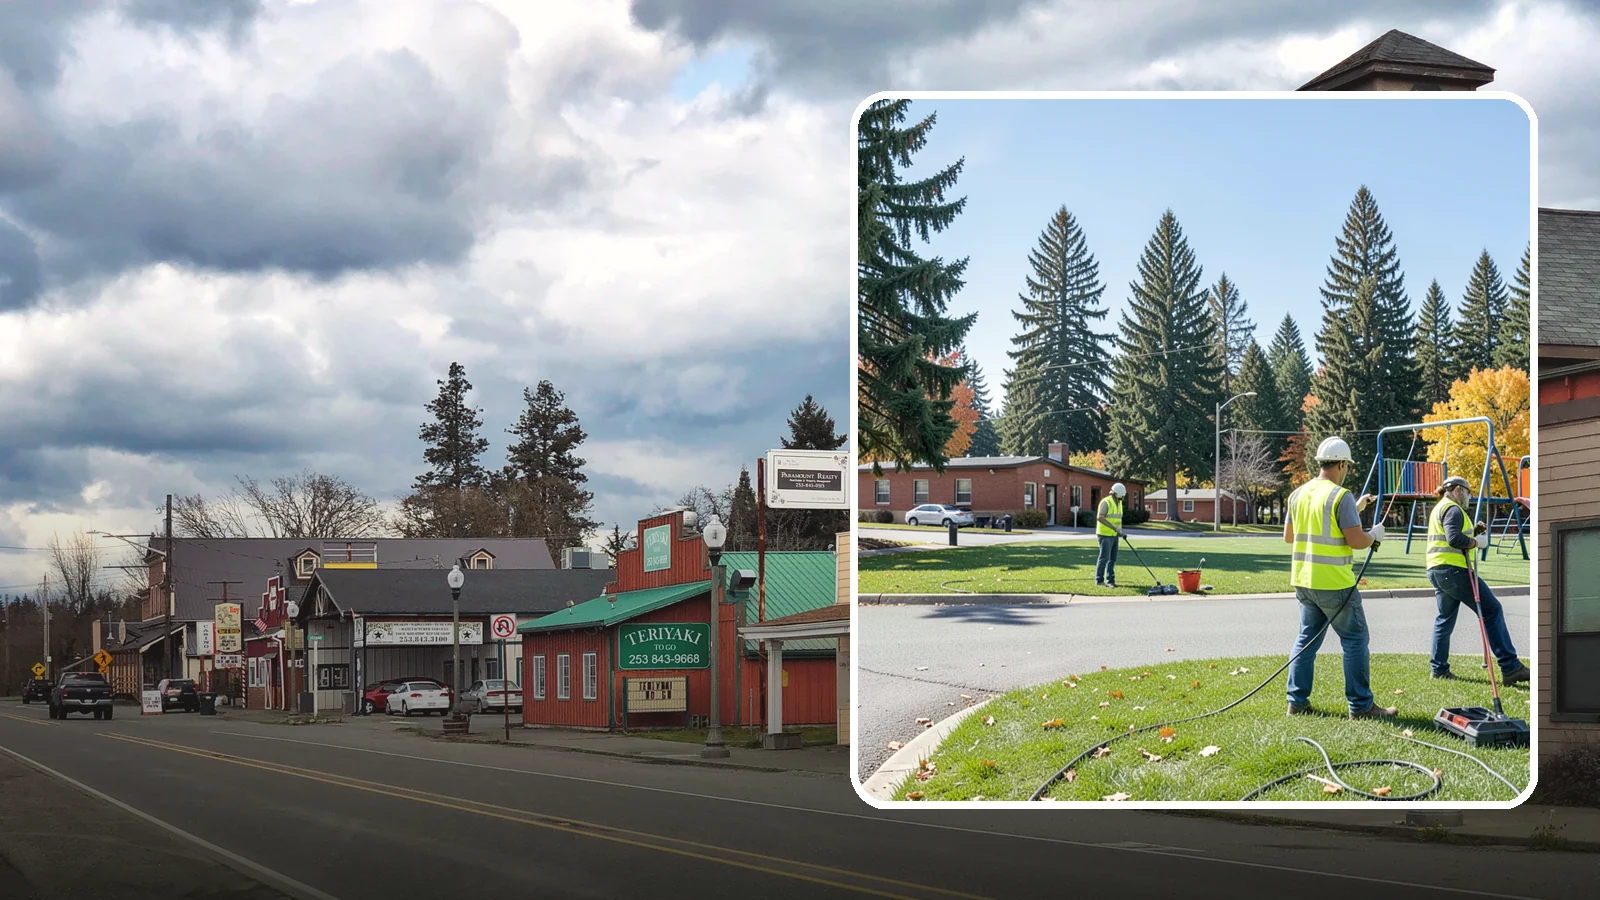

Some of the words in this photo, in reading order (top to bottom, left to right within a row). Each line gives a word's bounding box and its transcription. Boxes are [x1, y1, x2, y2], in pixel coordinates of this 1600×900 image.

[781, 471, 815, 479] PARAMOUNT
[624, 627, 702, 646] TERIYAKI
[628, 654, 648, 664] 253
[651, 653, 700, 664] 843-9668
